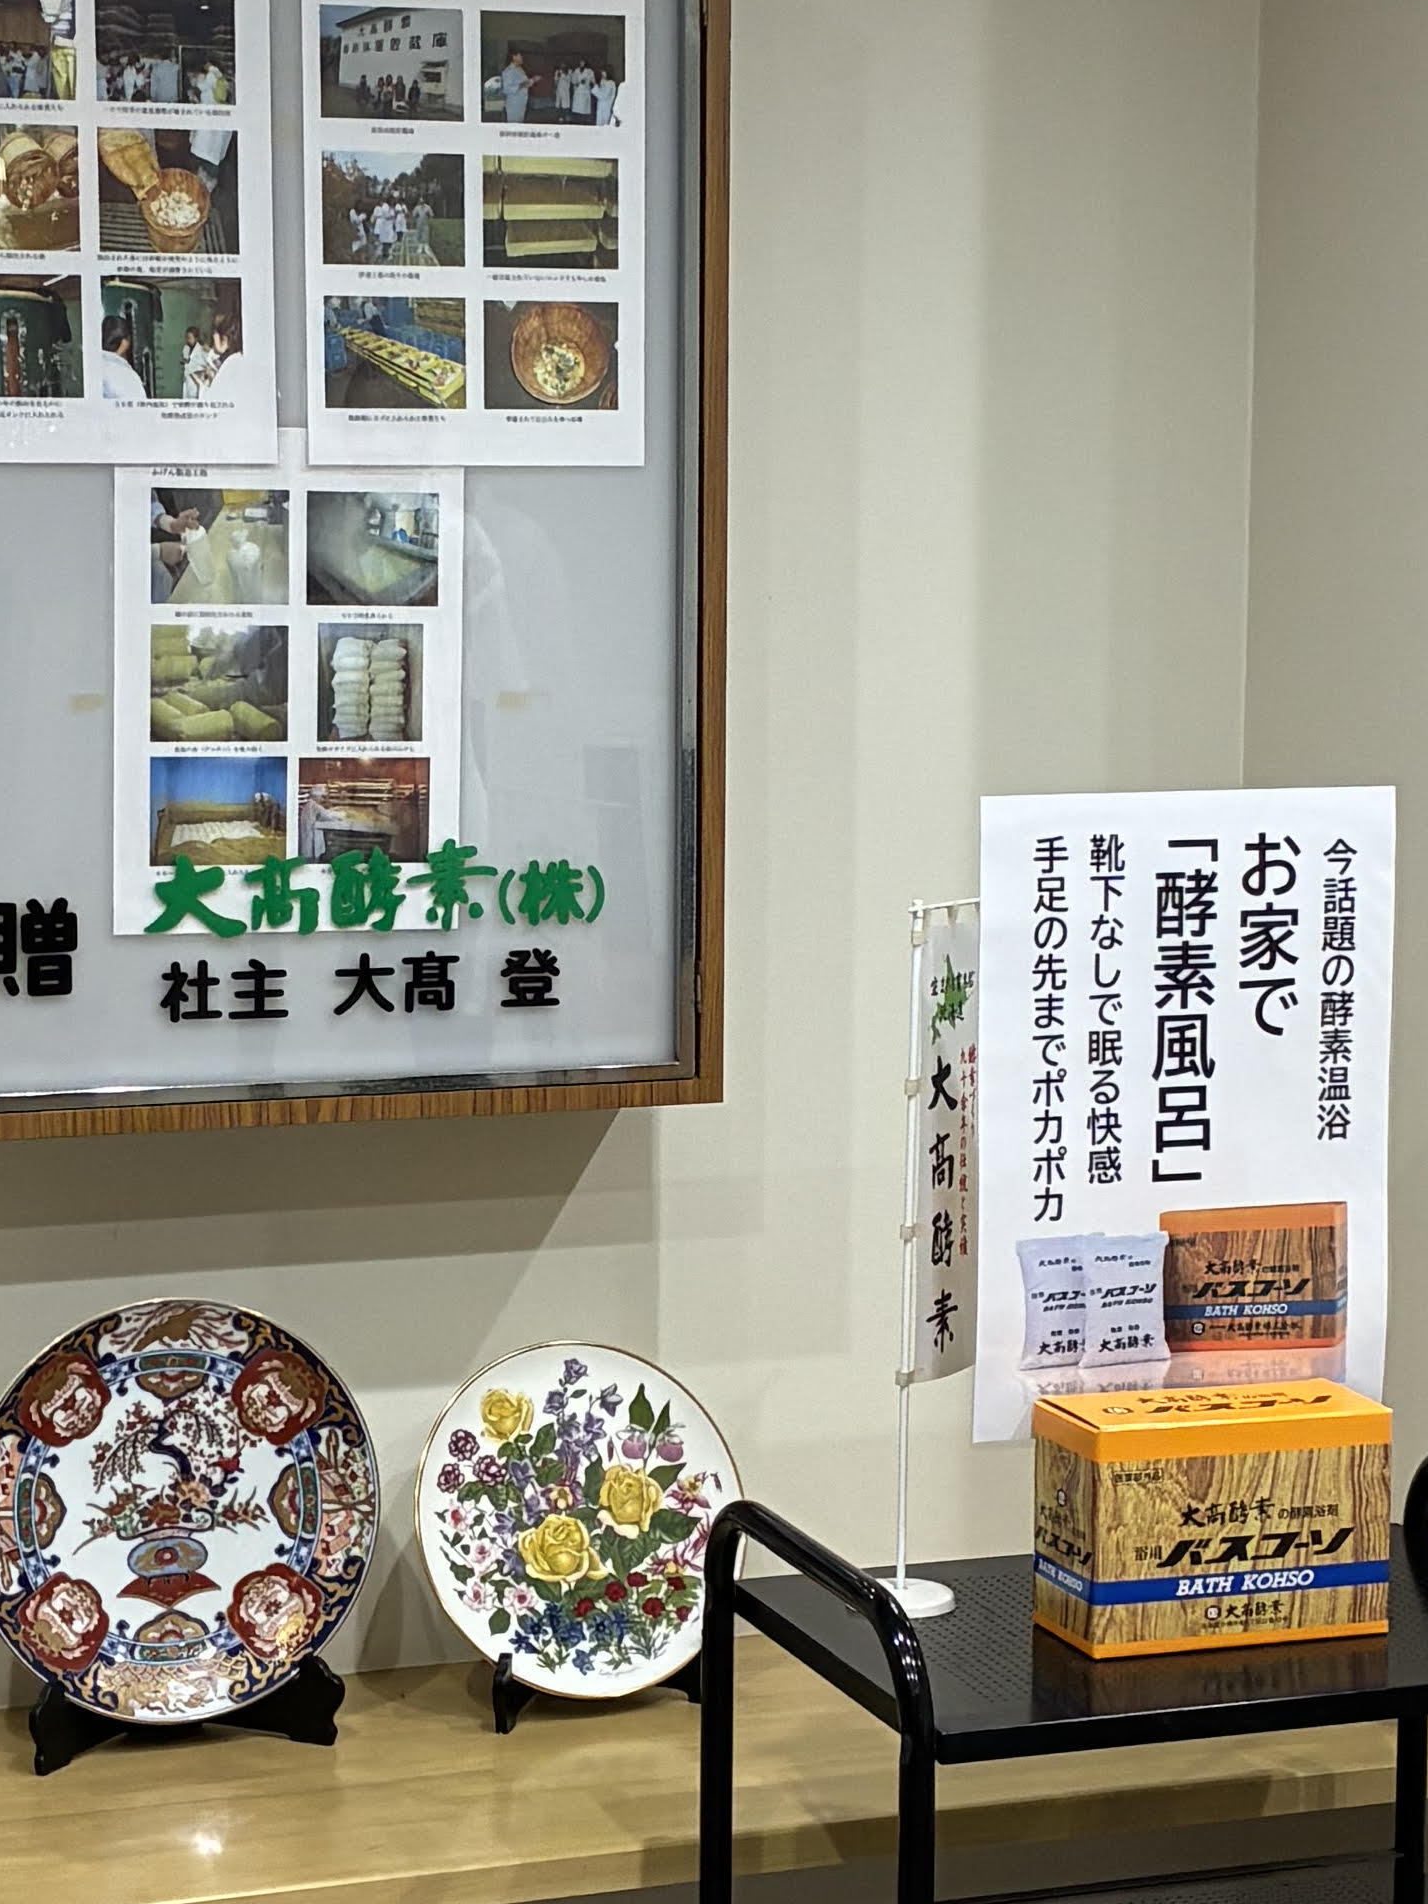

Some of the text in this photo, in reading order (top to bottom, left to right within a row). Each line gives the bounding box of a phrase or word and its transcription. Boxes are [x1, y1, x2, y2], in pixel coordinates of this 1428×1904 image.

[160, 958, 289, 1022] 社主
[500, 948, 561, 1008] 登
[1239, 832, 1301, 1037] お家で
[1317, 838, 1358, 1141] 今話題の酵素温浴
[1032, 835, 1069, 1222] 手足の先までポカポカ
[1086, 833, 1126, 1185] 靴下なしで眠る快感
[1151, 838, 1219, 1183] 「酵素風呂」
[1192, 1278, 1311, 1299] バスコーソ
[1204, 1303, 1288, 1316] BATH KOHSO
[1156, 1526, 1355, 1568] バスコーソ
[1175, 1569, 1315, 1597] BATH KOHSO
